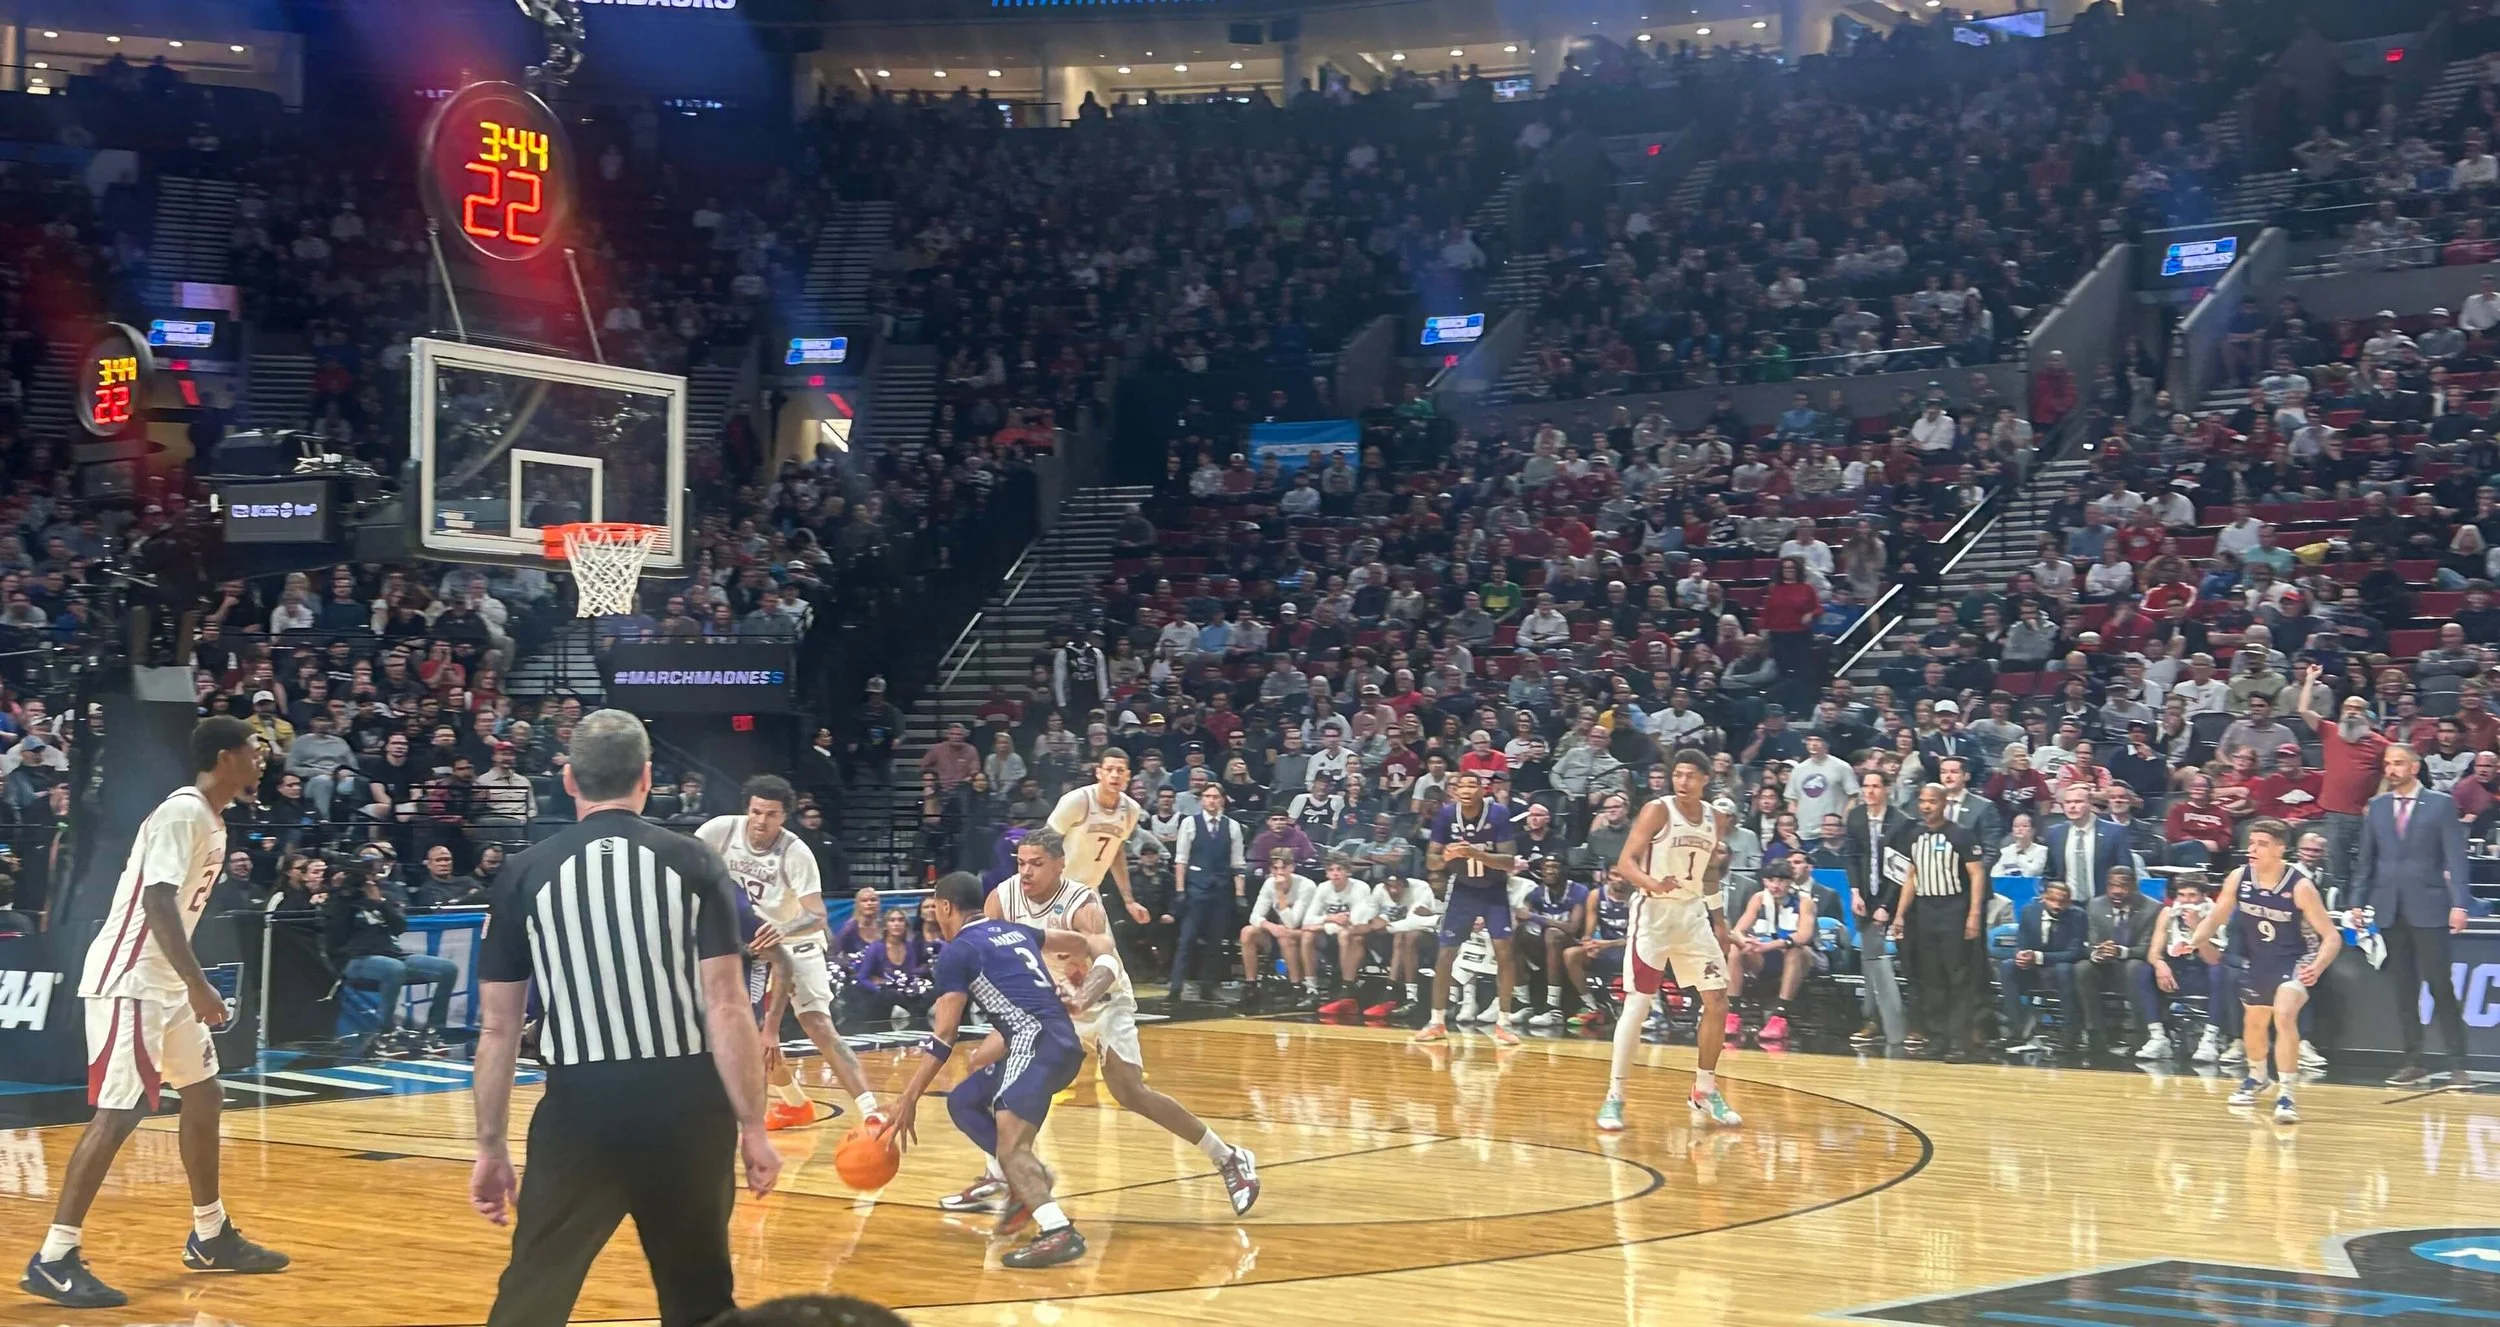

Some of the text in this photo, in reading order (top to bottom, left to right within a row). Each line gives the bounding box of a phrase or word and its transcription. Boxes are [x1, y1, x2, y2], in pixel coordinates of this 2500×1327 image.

[479, 121, 548, 171] 3:44
[464, 162, 541, 242] 22
[98, 356, 137, 386] 3:44
[94, 386, 131, 424] 22
[614, 670, 785, 685] #MARCHMADNESS
[1094, 836, 1111, 861] 7
[1466, 857, 1485, 878] 11
[1684, 851, 1697, 881] 1
[2257, 920, 2276, 943] 9
[1014, 946, 1052, 989] 3
